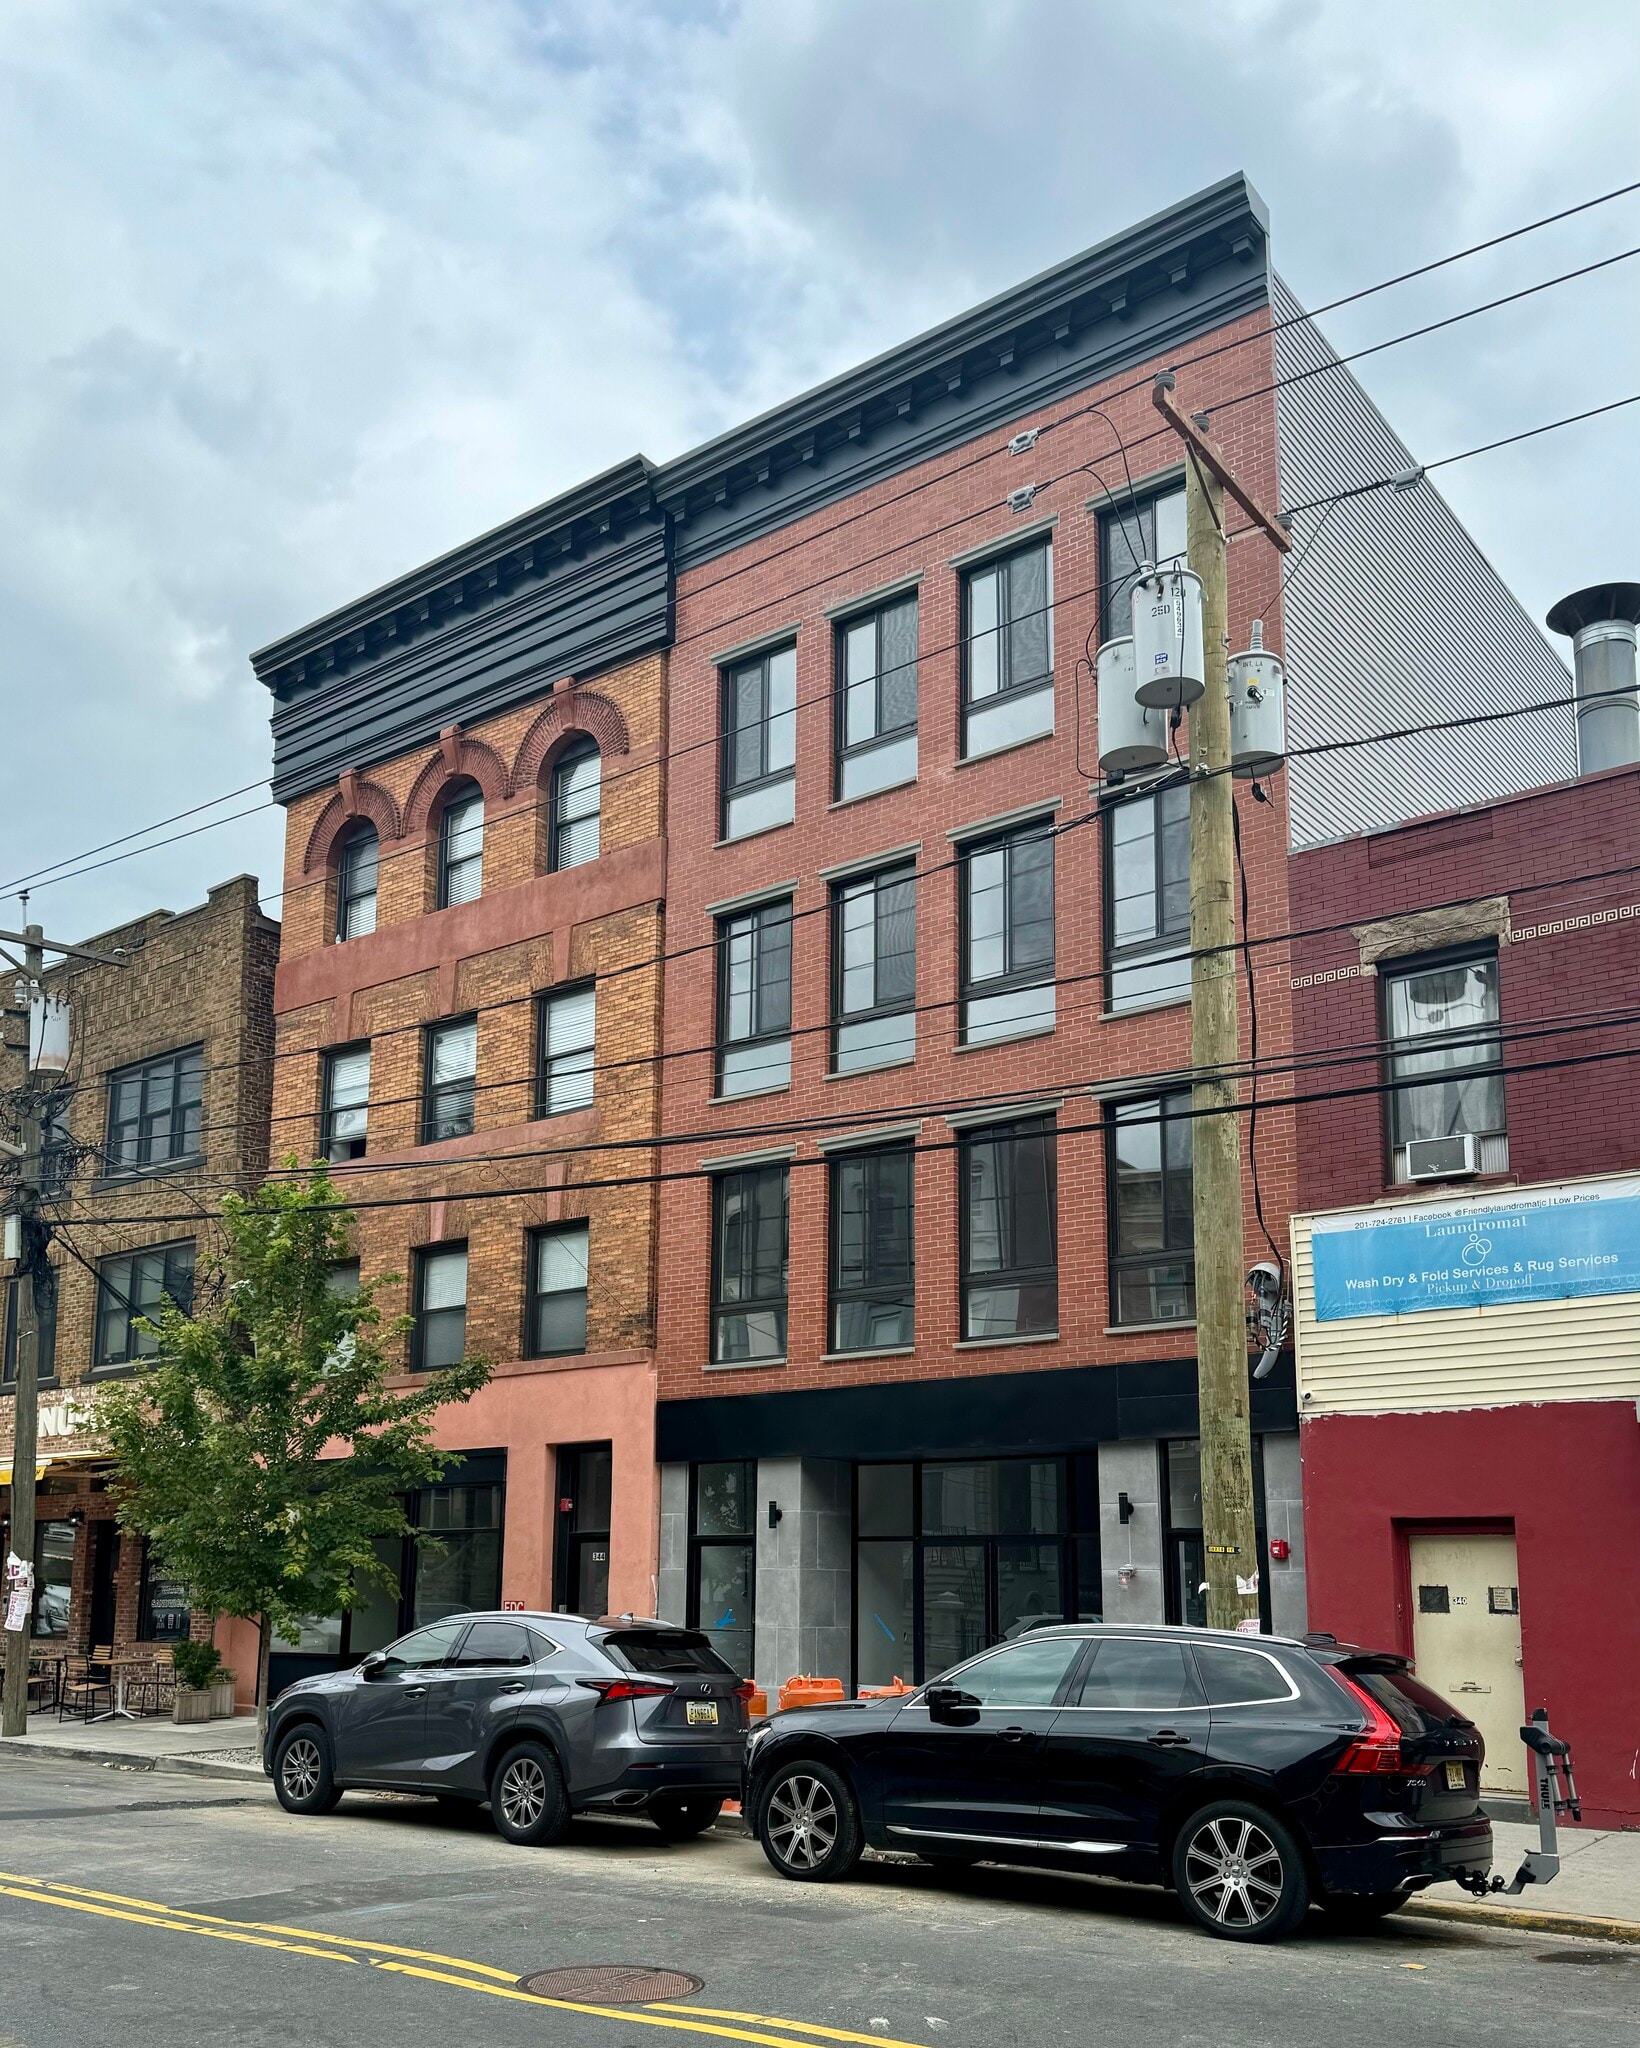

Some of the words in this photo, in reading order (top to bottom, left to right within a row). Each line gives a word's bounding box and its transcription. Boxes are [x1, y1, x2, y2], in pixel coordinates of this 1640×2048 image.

[1413, 1211, 1452, 1222] Facebook
[1553, 1197, 1571, 1205] Low
[1573, 1193, 1600, 1202] Prices
[1425, 1215, 1528, 1238] Laundromat
[1345, 1277, 1378, 1290] Wash
[1383, 1275, 1404, 1287] Dry
[1408, 1273, 1418, 1284] &
[1421, 1270, 1449, 1282] Fold
[1452, 1264, 1509, 1279] Services
[1513, 1262, 1523, 1273] &
[1527, 1260, 1554, 1272] Rug
[1558, 1253, 1619, 1268] Services
[1427, 1281, 1467, 1294] Pickup
[1471, 1278, 1481, 1290] &
[1486, 1273, 1535, 1288] Dropoff
[1452, 1596, 1467, 1605] 340
[1540, 1777, 1550, 1810] THULE
